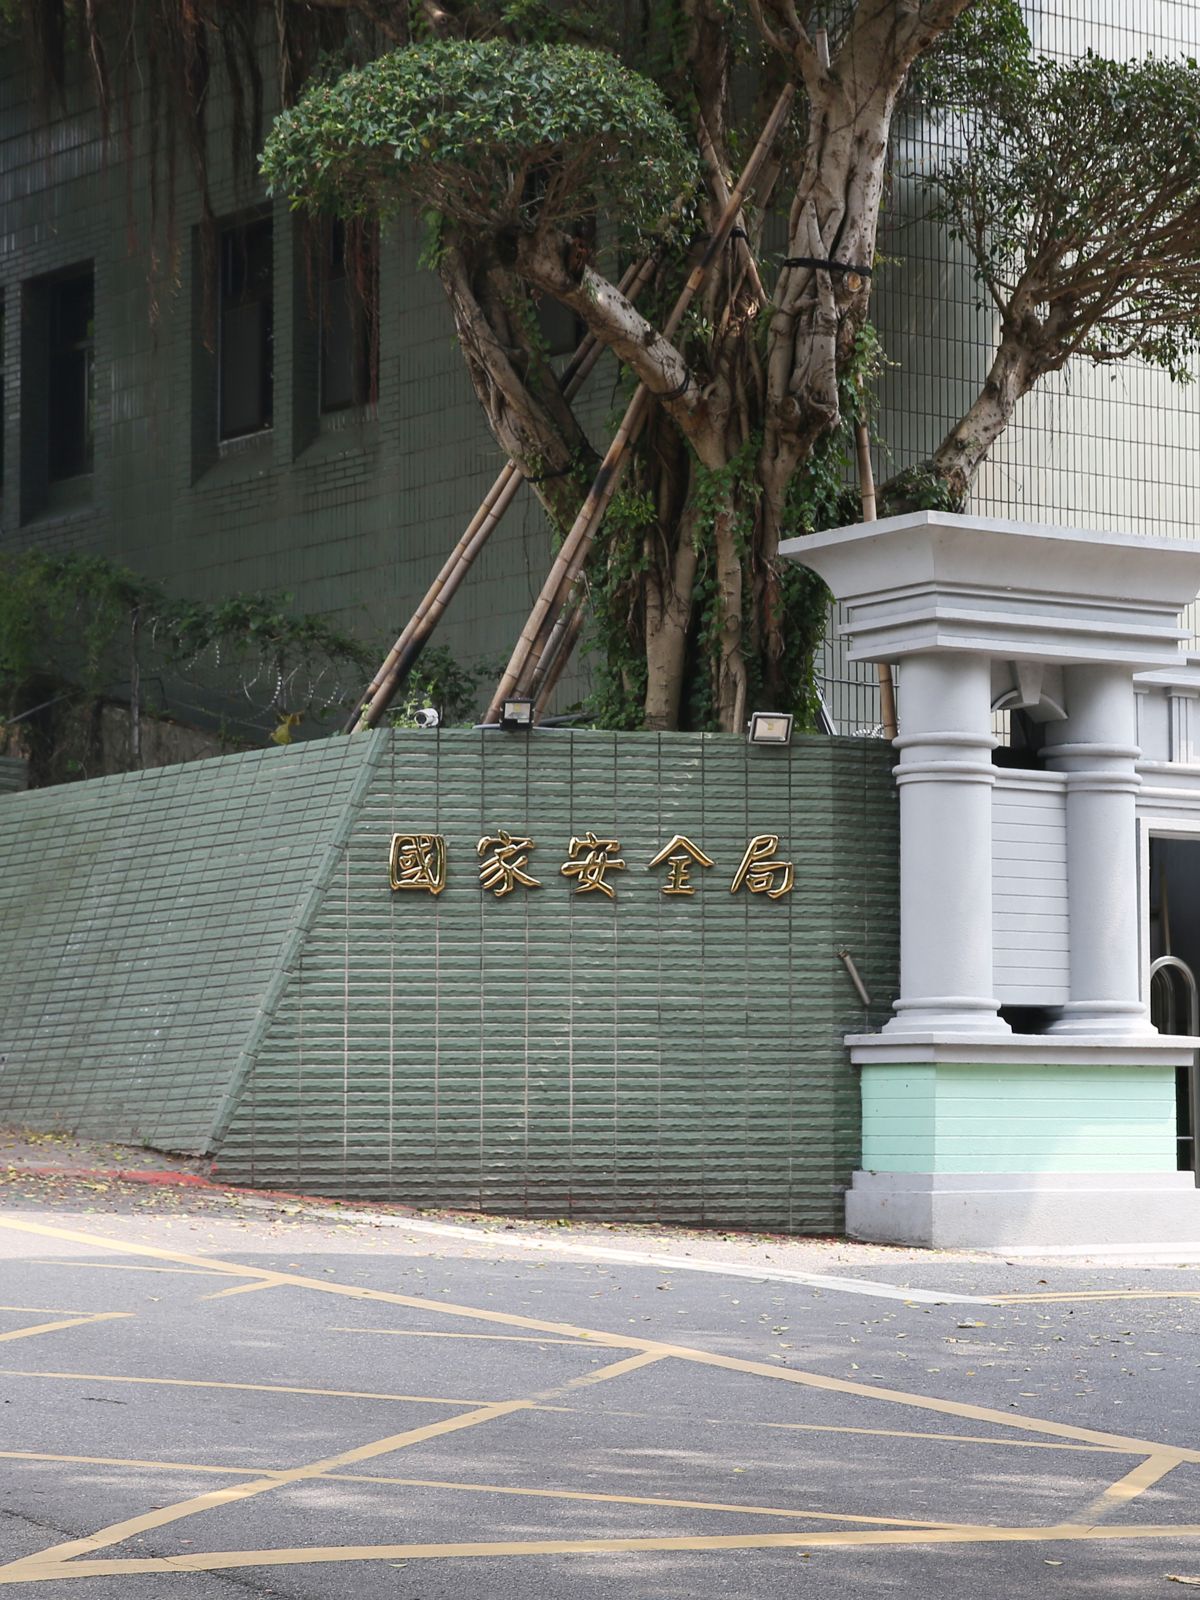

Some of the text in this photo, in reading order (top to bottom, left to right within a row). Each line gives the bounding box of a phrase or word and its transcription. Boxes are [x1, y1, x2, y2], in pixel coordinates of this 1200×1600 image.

[389, 829, 796, 899] 國家安全局
